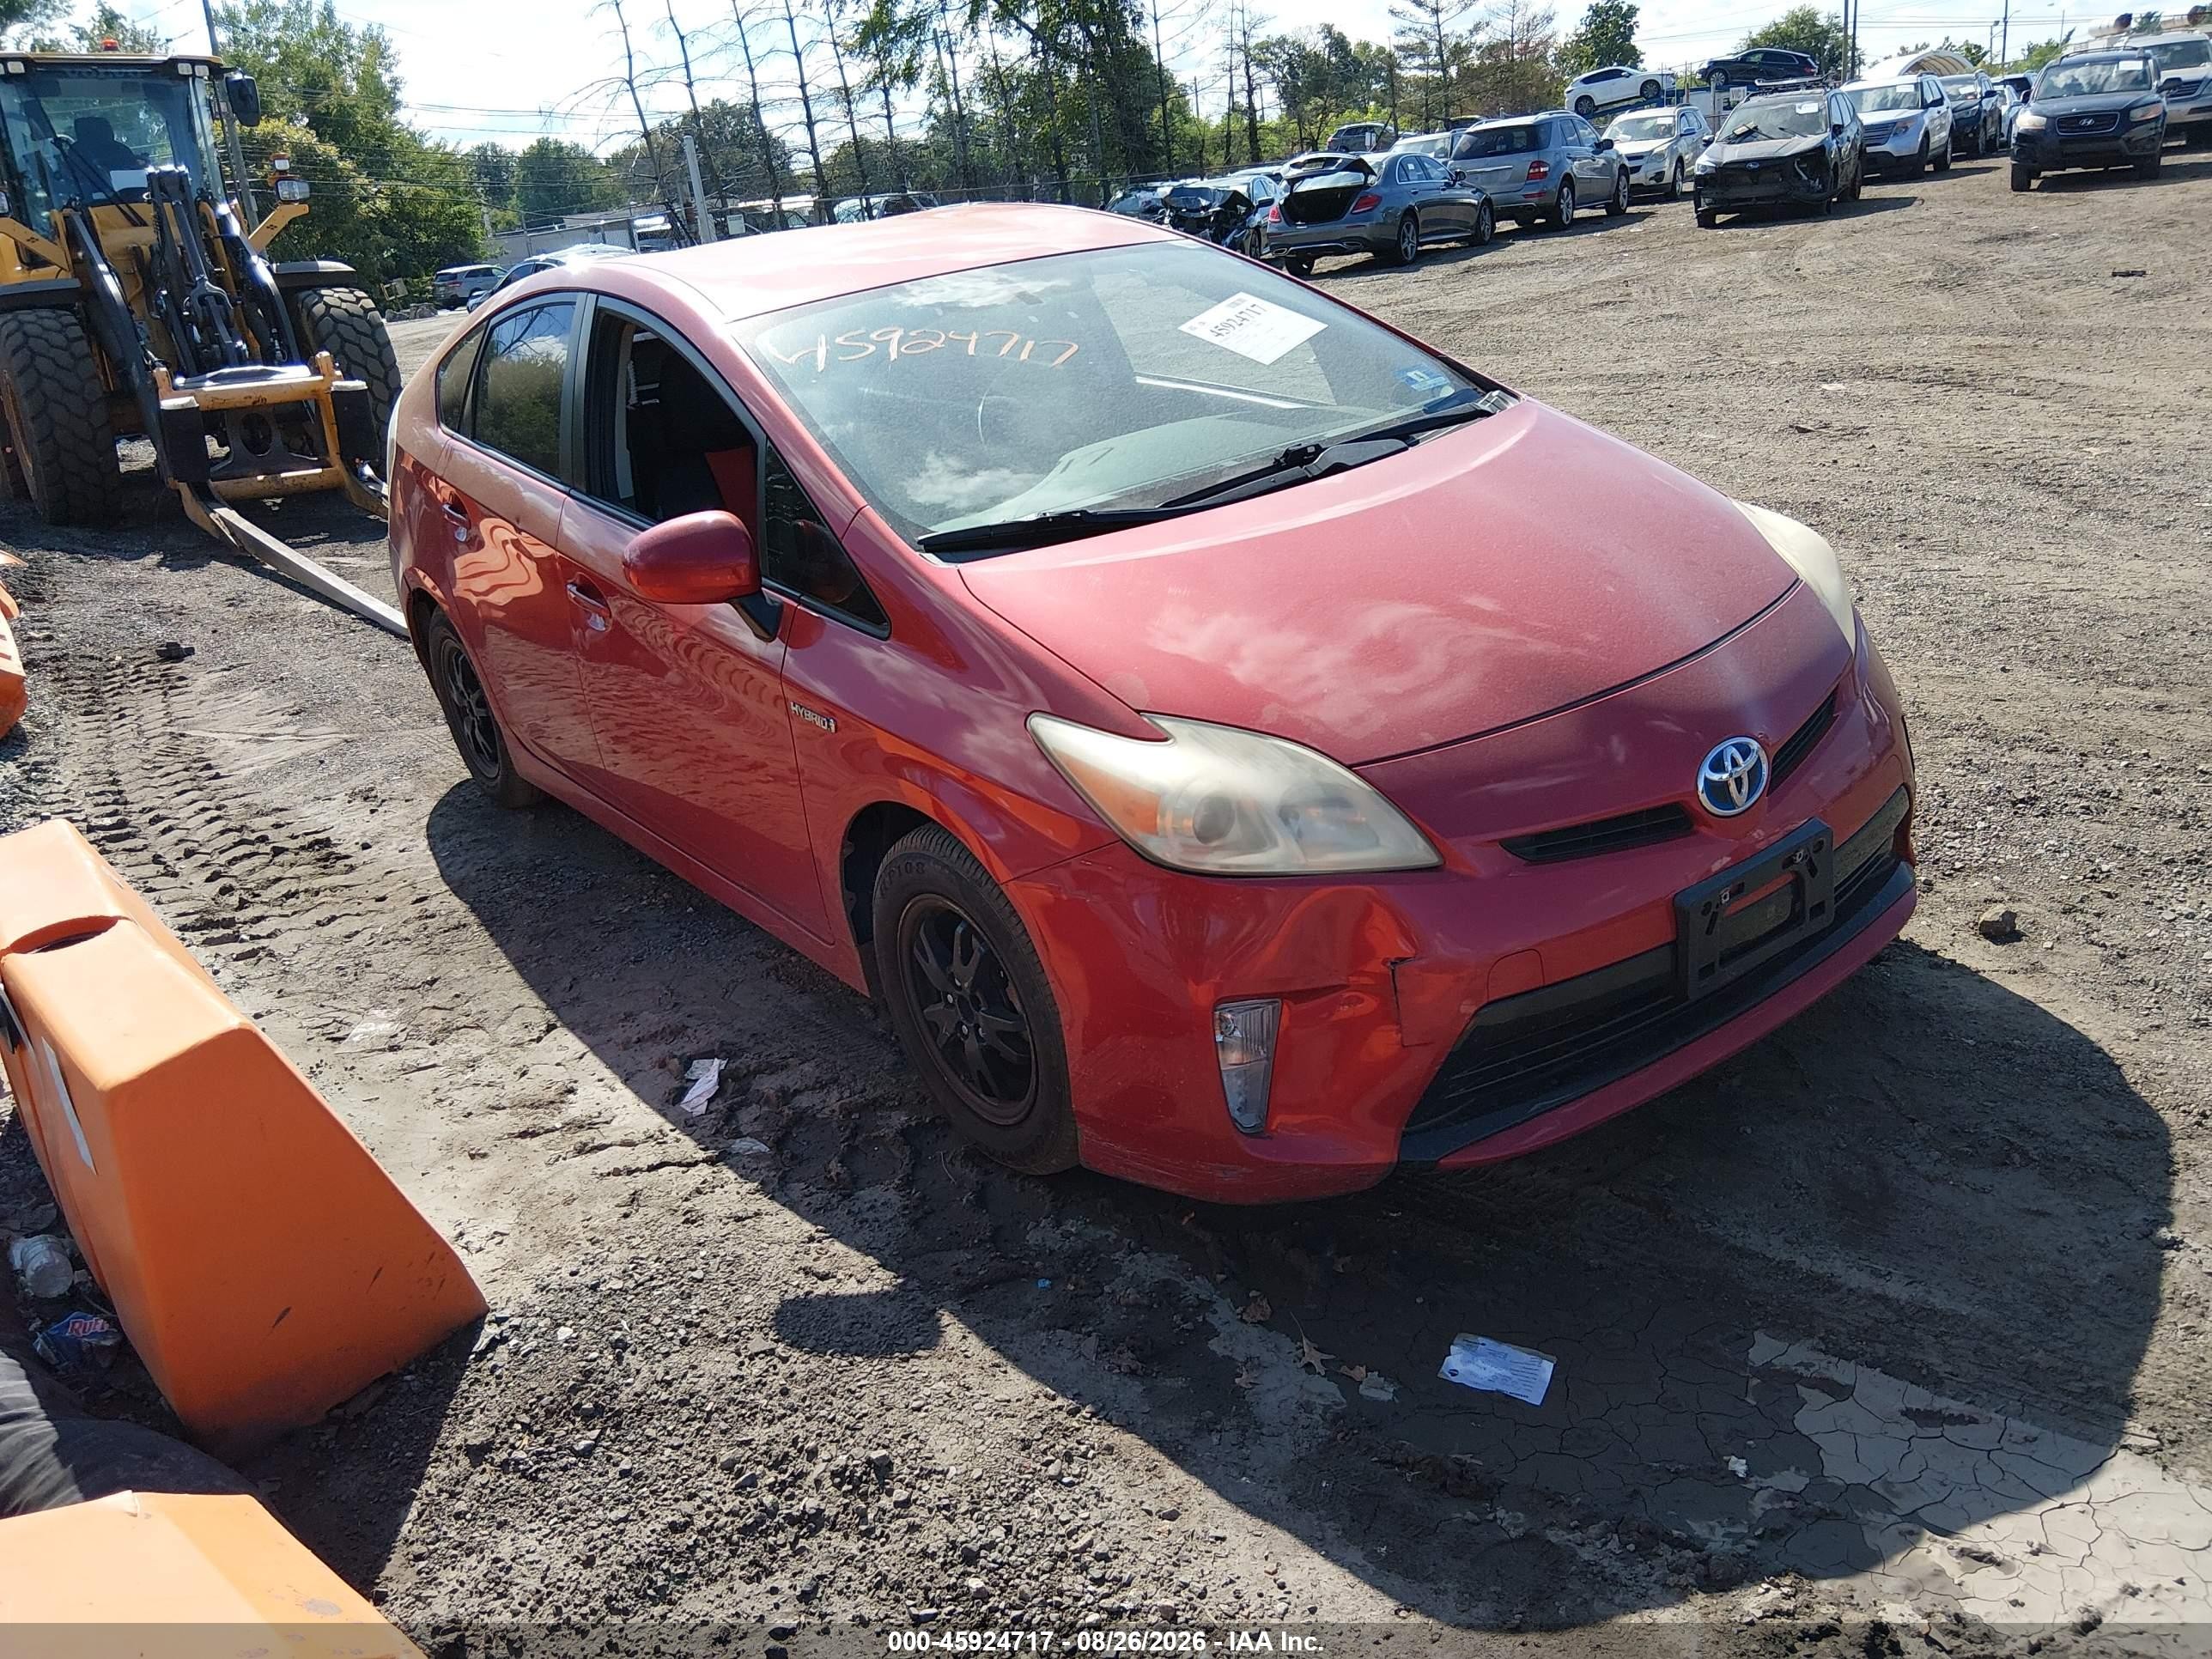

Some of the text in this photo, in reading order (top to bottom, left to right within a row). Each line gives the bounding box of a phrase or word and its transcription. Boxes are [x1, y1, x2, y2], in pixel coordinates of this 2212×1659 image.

[1209, 303, 1268, 337] 45924717
[768, 325, 1079, 373] 45924717
[790, 702, 828, 730] HYBRID
